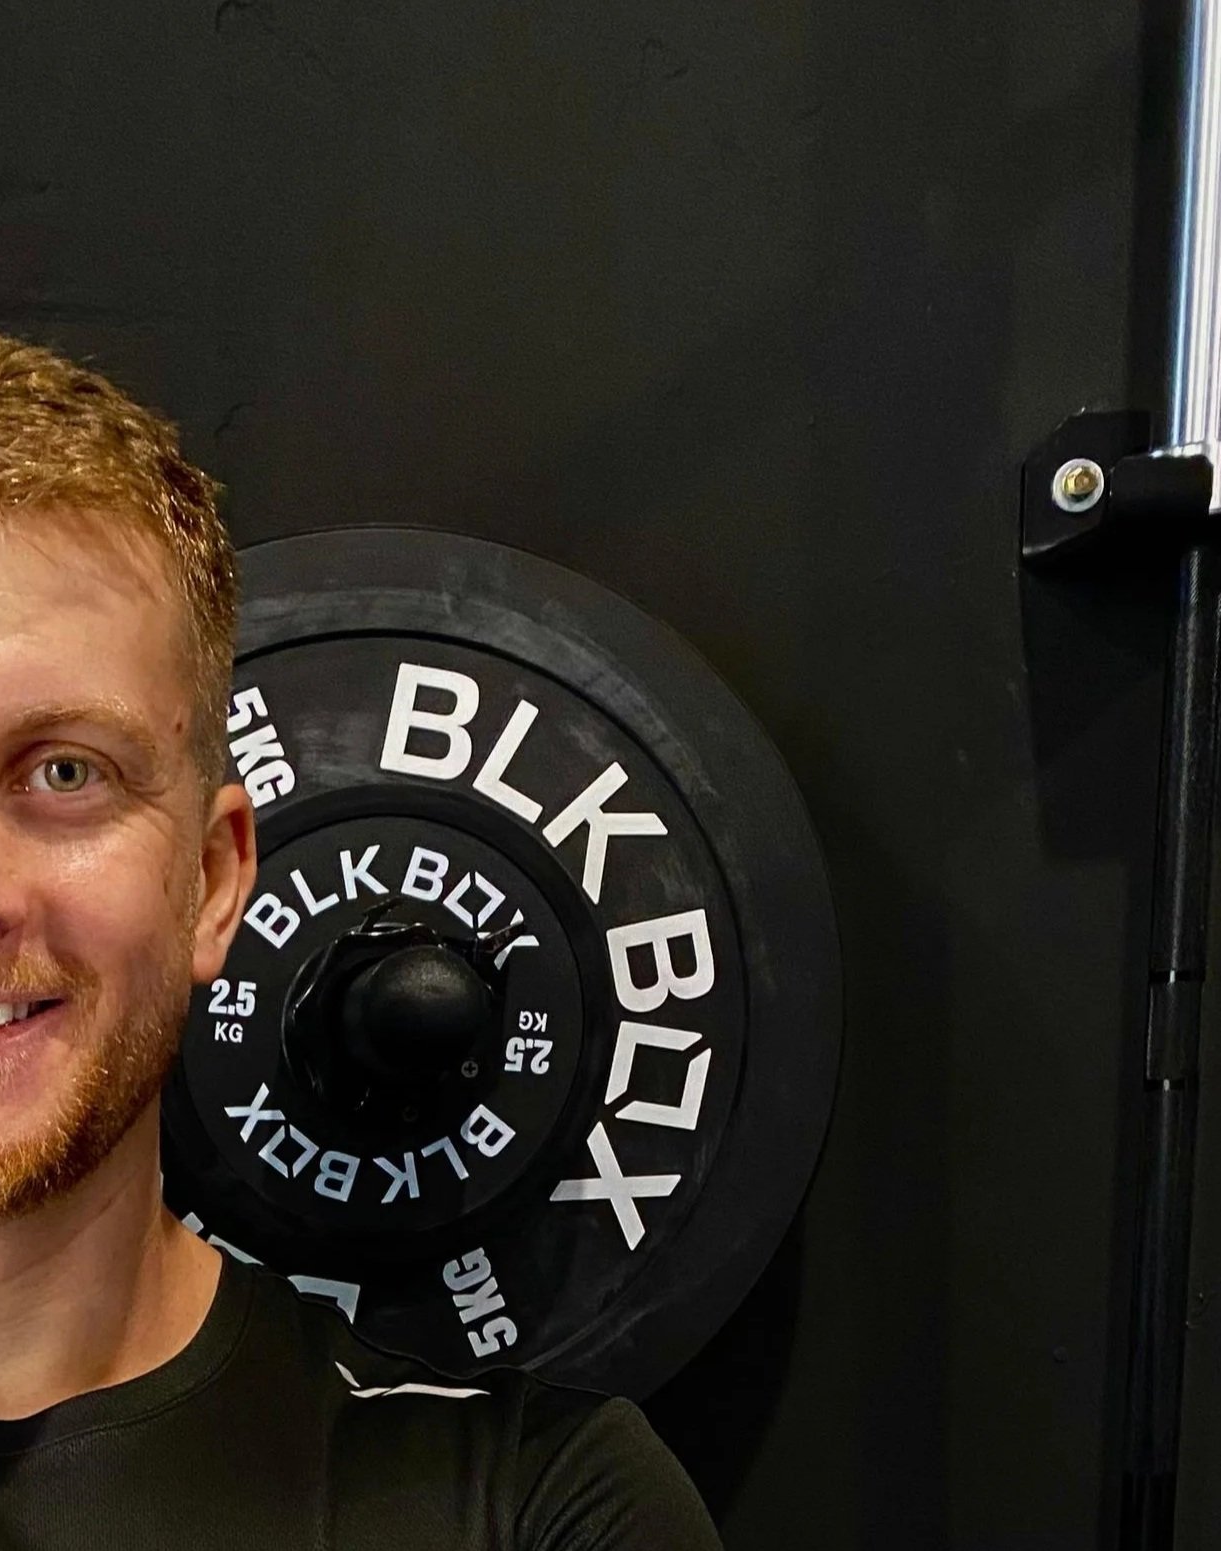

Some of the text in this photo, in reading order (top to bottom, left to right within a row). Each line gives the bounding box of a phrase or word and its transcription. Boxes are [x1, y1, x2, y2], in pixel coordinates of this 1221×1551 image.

[226, 686, 296, 808] 5KG
[243, 845, 389, 949] BLK
[208, 979, 257, 1016] 2.5
[380, 663, 714, 1250] BLK BOX
[214, 1021, 243, 1043] KG
[504, 1036, 554, 1075] 2.5
[519, 1010, 548, 1033] KG
[224, 1083, 515, 1203] BLK BOX
[443, 1247, 518, 1358] 5KG
